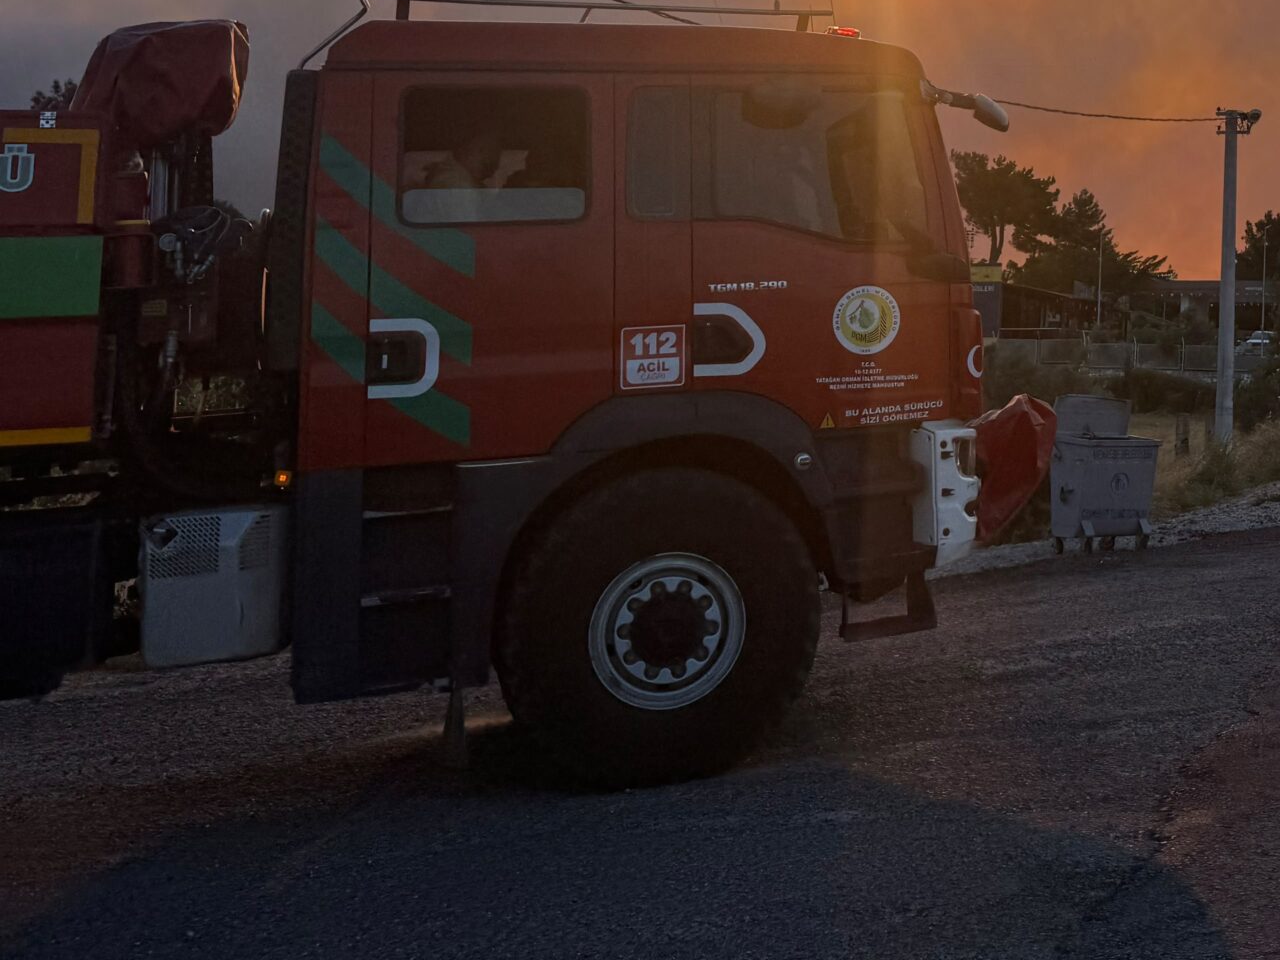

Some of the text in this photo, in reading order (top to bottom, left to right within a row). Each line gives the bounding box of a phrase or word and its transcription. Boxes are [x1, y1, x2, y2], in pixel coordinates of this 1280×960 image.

[708, 280, 788, 293] TGM 18.290
[630, 331, 677, 356] 112
[637, 360, 670, 373] ACİL
[845, 399, 944, 417] BU ALANDA SÜRÜCÜ
[860, 410, 929, 425] SİZİ GÖREMEZ
